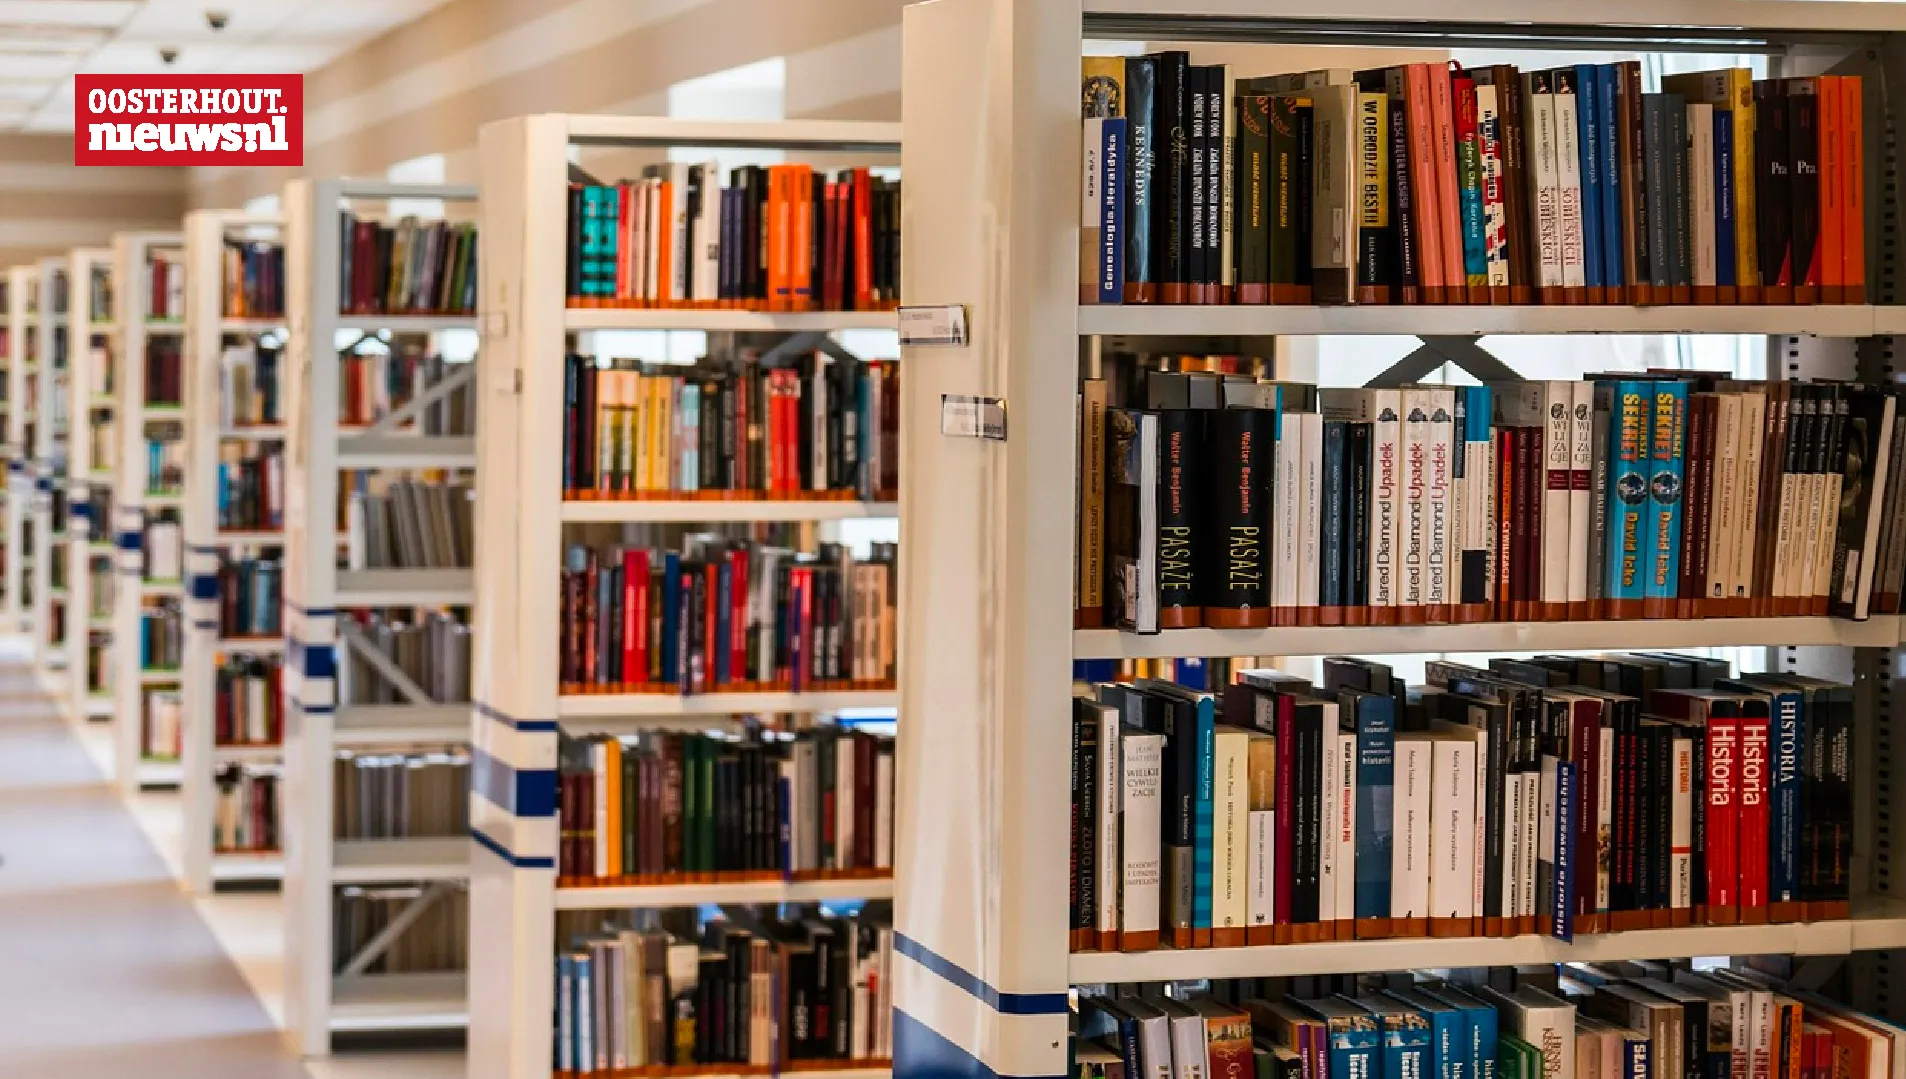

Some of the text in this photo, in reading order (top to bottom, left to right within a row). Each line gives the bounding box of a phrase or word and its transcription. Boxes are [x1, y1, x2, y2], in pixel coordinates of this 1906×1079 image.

[1364, 100, 1378, 114] W
[1134, 125, 1146, 206] KENNEDYS
[1364, 117, 1378, 180] OGRODZIE
[1621, 393, 1639, 462] SEKRET
[1654, 393, 1672, 462] SEKRET
[1161, 431, 1193, 590] Walter Benjamin PASAŻE
[1230, 431, 1262, 590] Walter Benjamin PASAŻE
[1377, 443, 1394, 606] Jared Diamond Upadek
[1406, 443, 1423, 606] Jared Diamond Upadek
[1429, 443, 1448, 604] Jared Diamond Upadek
[1624, 512, 1638, 551] David
[1657, 511, 1671, 585] David Icke
[1712, 724, 1736, 805] Historia
[1743, 724, 1767, 805] Historia
[1780, 700, 1796, 783] HISTORIA
[1555, 766, 1569, 936] Historia powszechna
